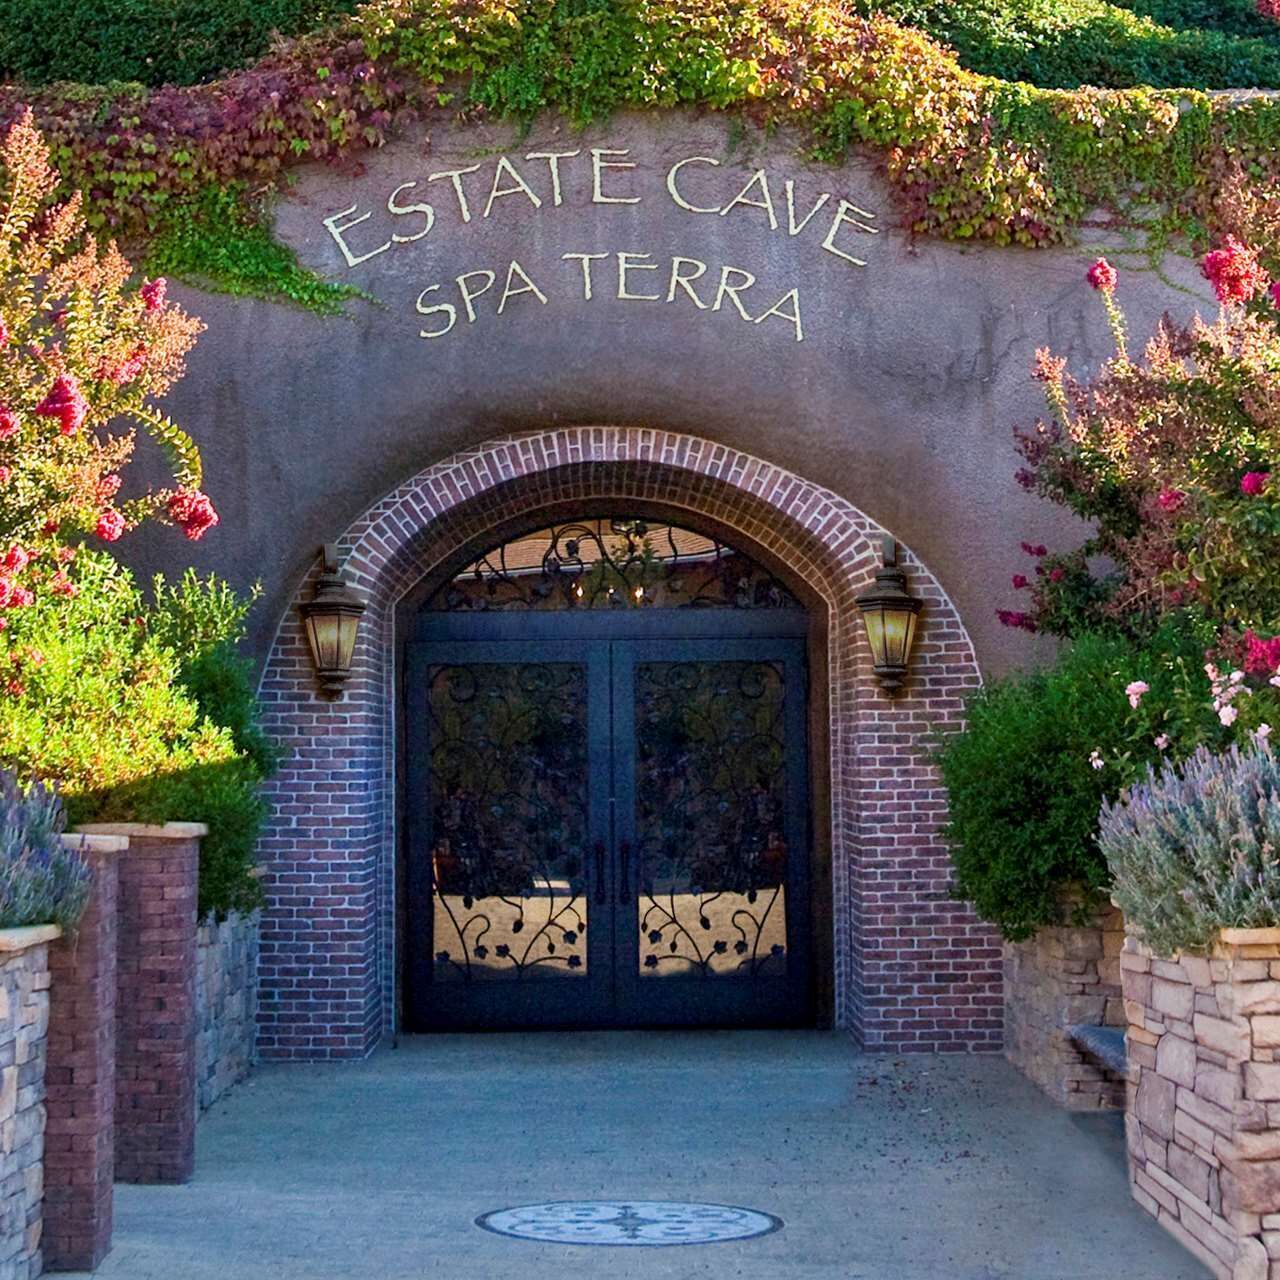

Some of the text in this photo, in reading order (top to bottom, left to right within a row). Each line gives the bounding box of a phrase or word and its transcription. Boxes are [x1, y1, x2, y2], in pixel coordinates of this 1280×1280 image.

[322, 148, 880, 267] ESTATE CAVE
[416, 252, 806, 341] SPA TERRA
